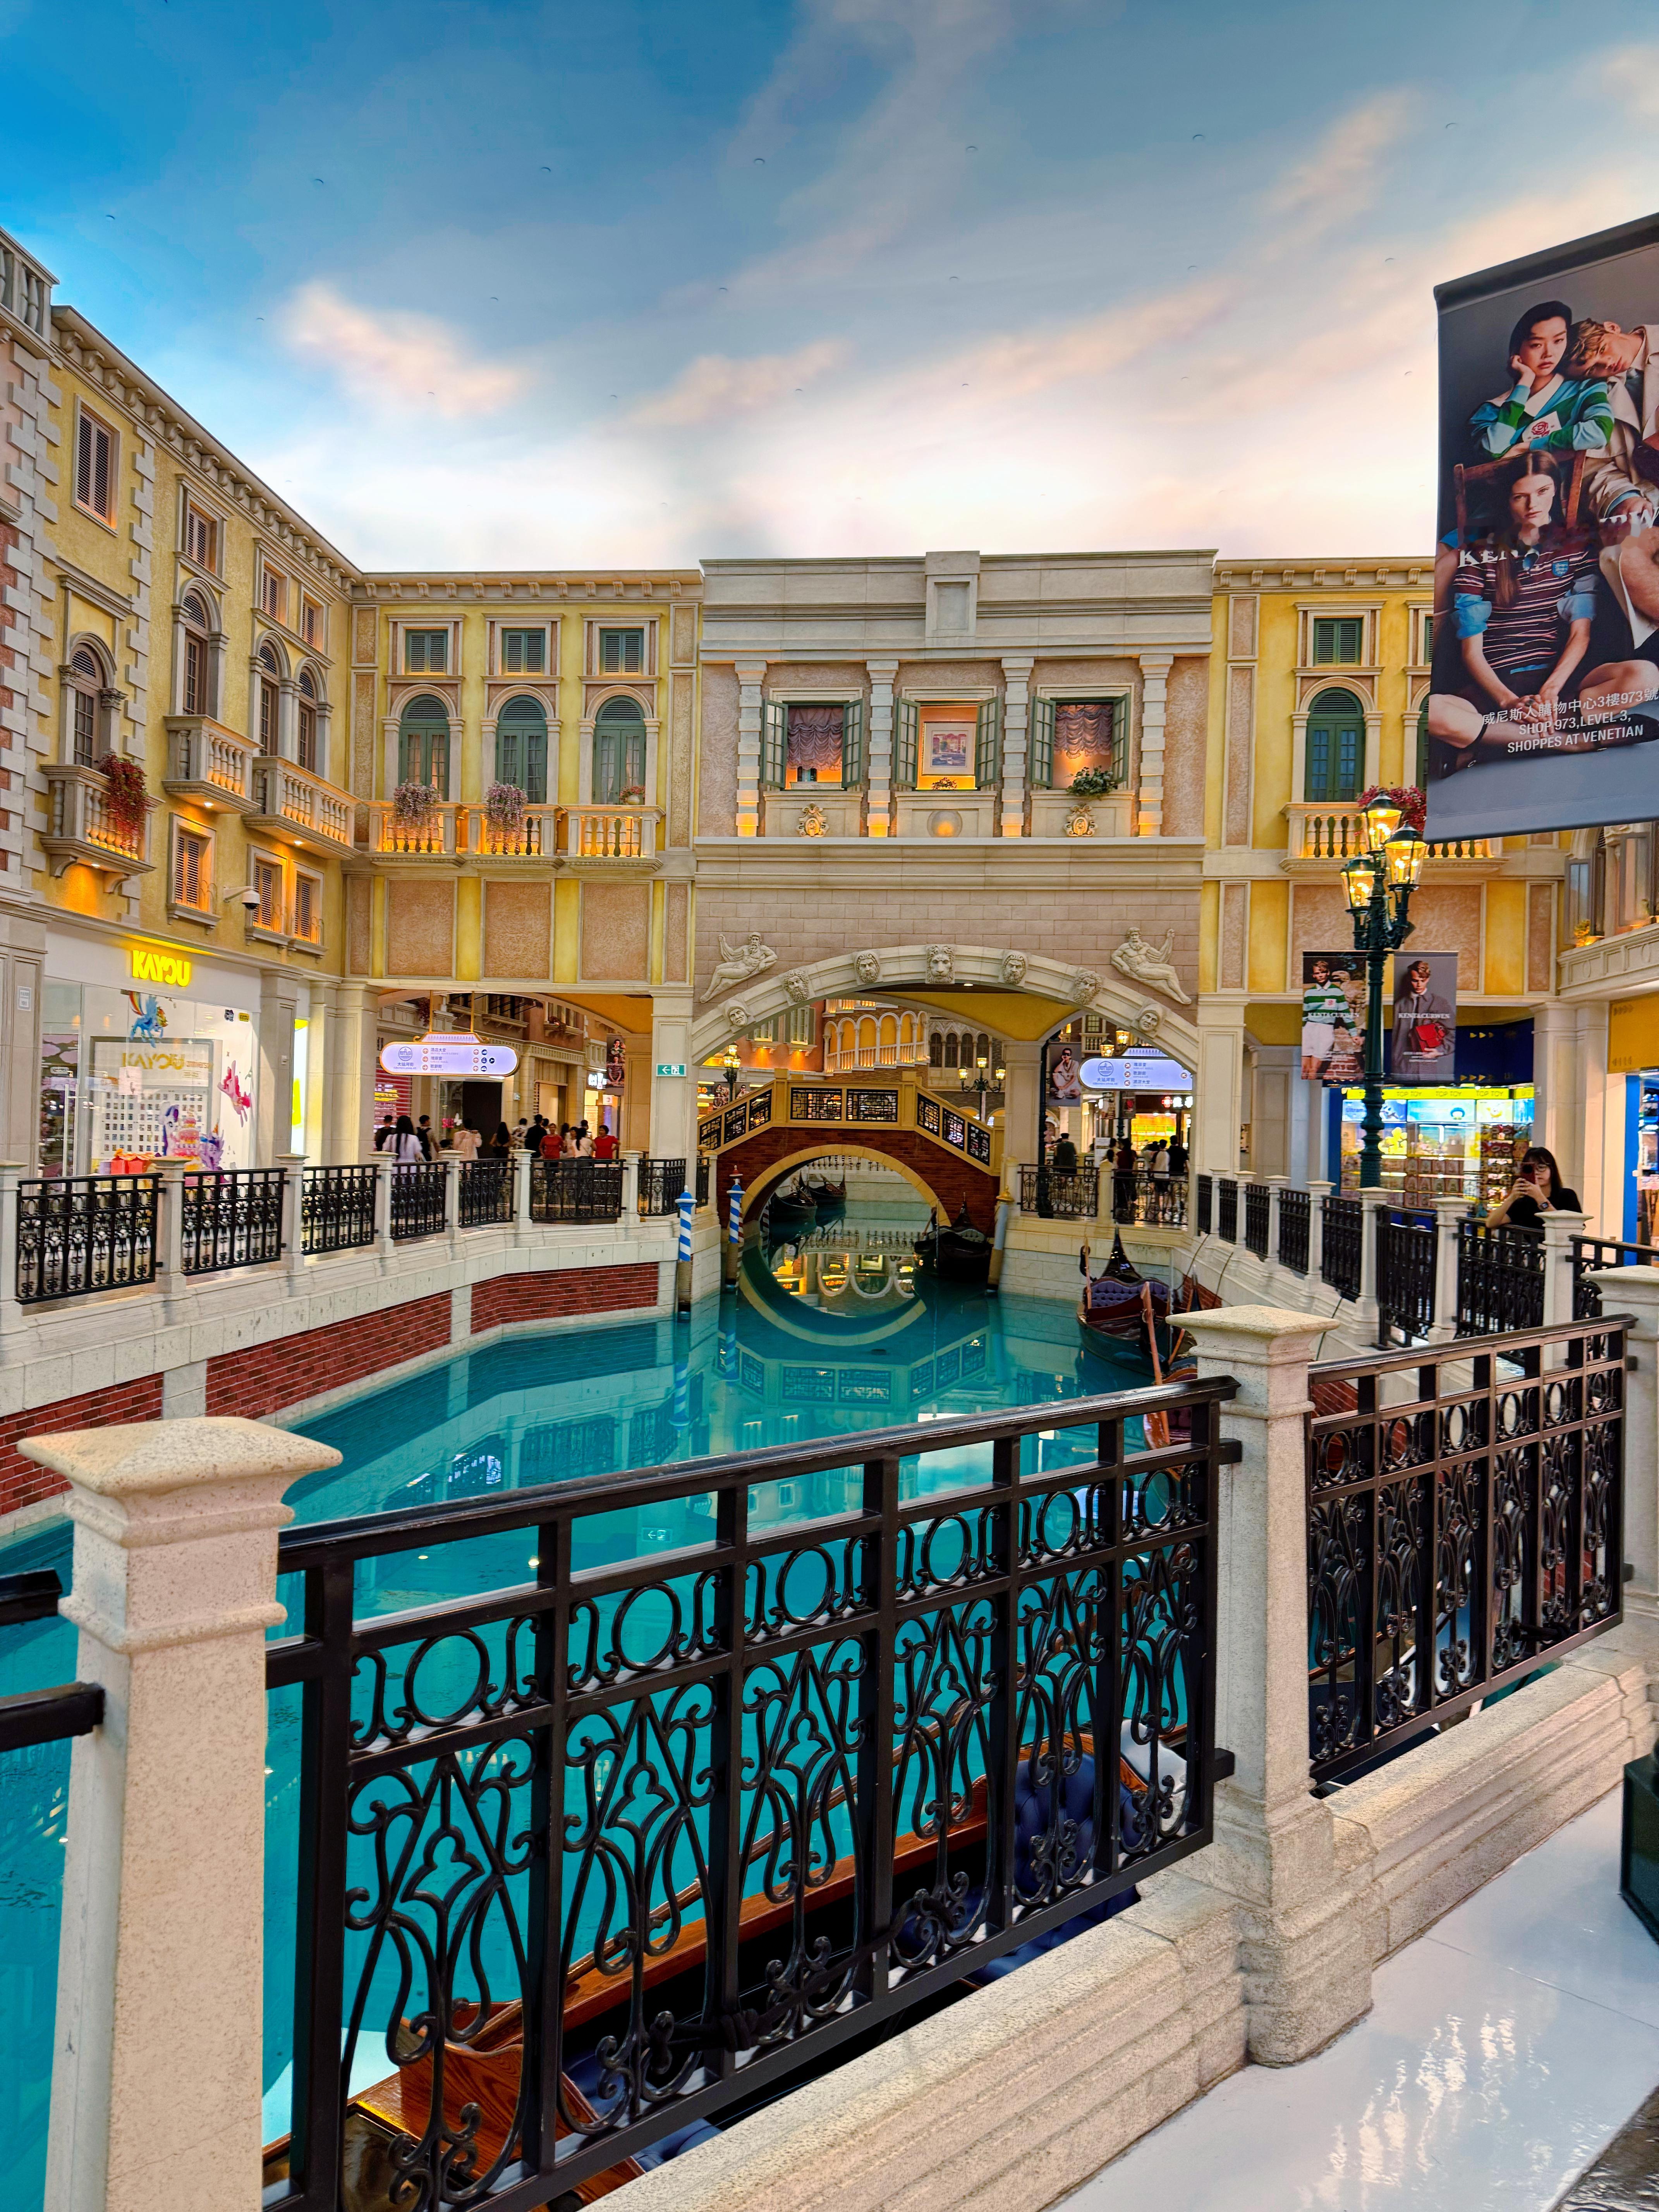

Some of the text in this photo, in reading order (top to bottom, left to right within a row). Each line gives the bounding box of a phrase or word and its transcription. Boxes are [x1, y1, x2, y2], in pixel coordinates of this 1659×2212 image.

[1483, 688, 1659, 725] 威尼斯人購物中心3樓973號
[1520, 721, 1551, 735] SHOP
[1620, 710, 1631, 722] 3,
[1508, 725, 1643, 753] SHOPPES AT VENETIAN
[132, 950, 191, 987] KAYOU
